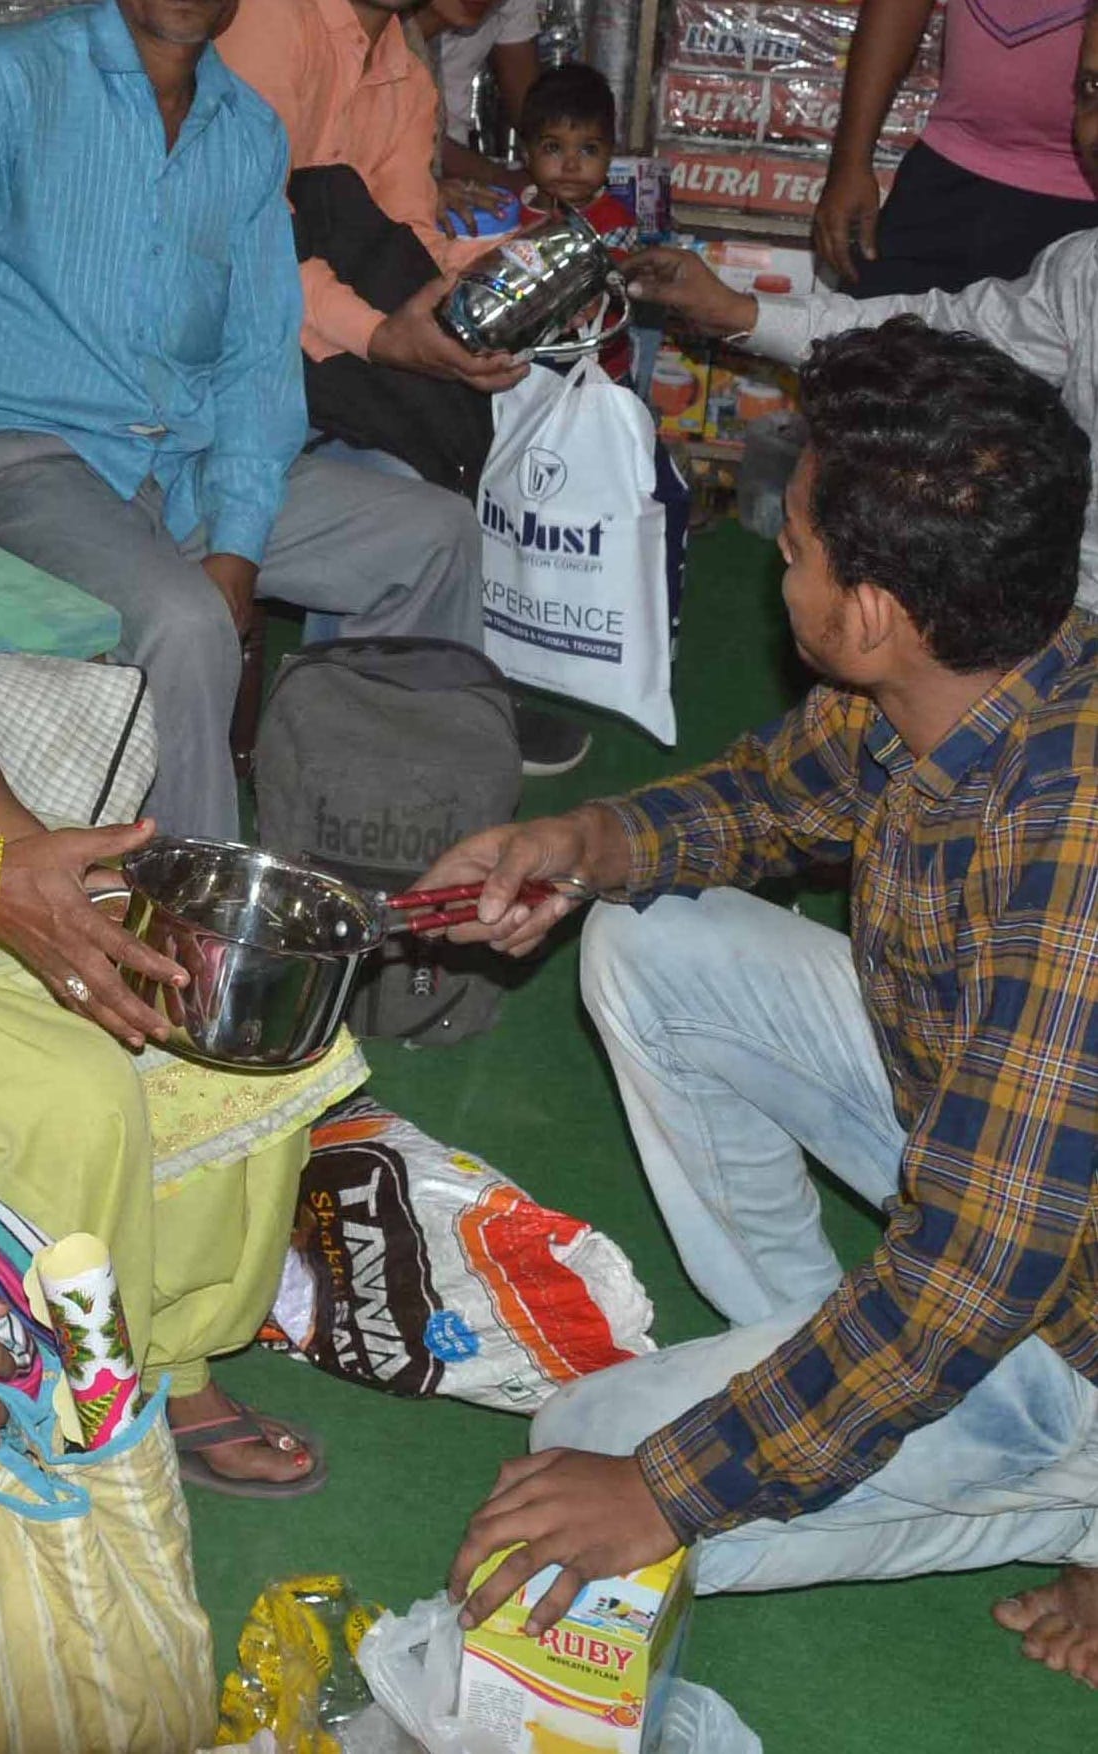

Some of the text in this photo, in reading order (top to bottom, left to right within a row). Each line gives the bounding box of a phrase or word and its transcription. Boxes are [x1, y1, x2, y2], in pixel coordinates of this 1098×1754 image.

[669, 161, 761, 198] ALTRA
[338, 1166, 412, 1382] TAWA
[537, 1627, 634, 1672] RUBY
